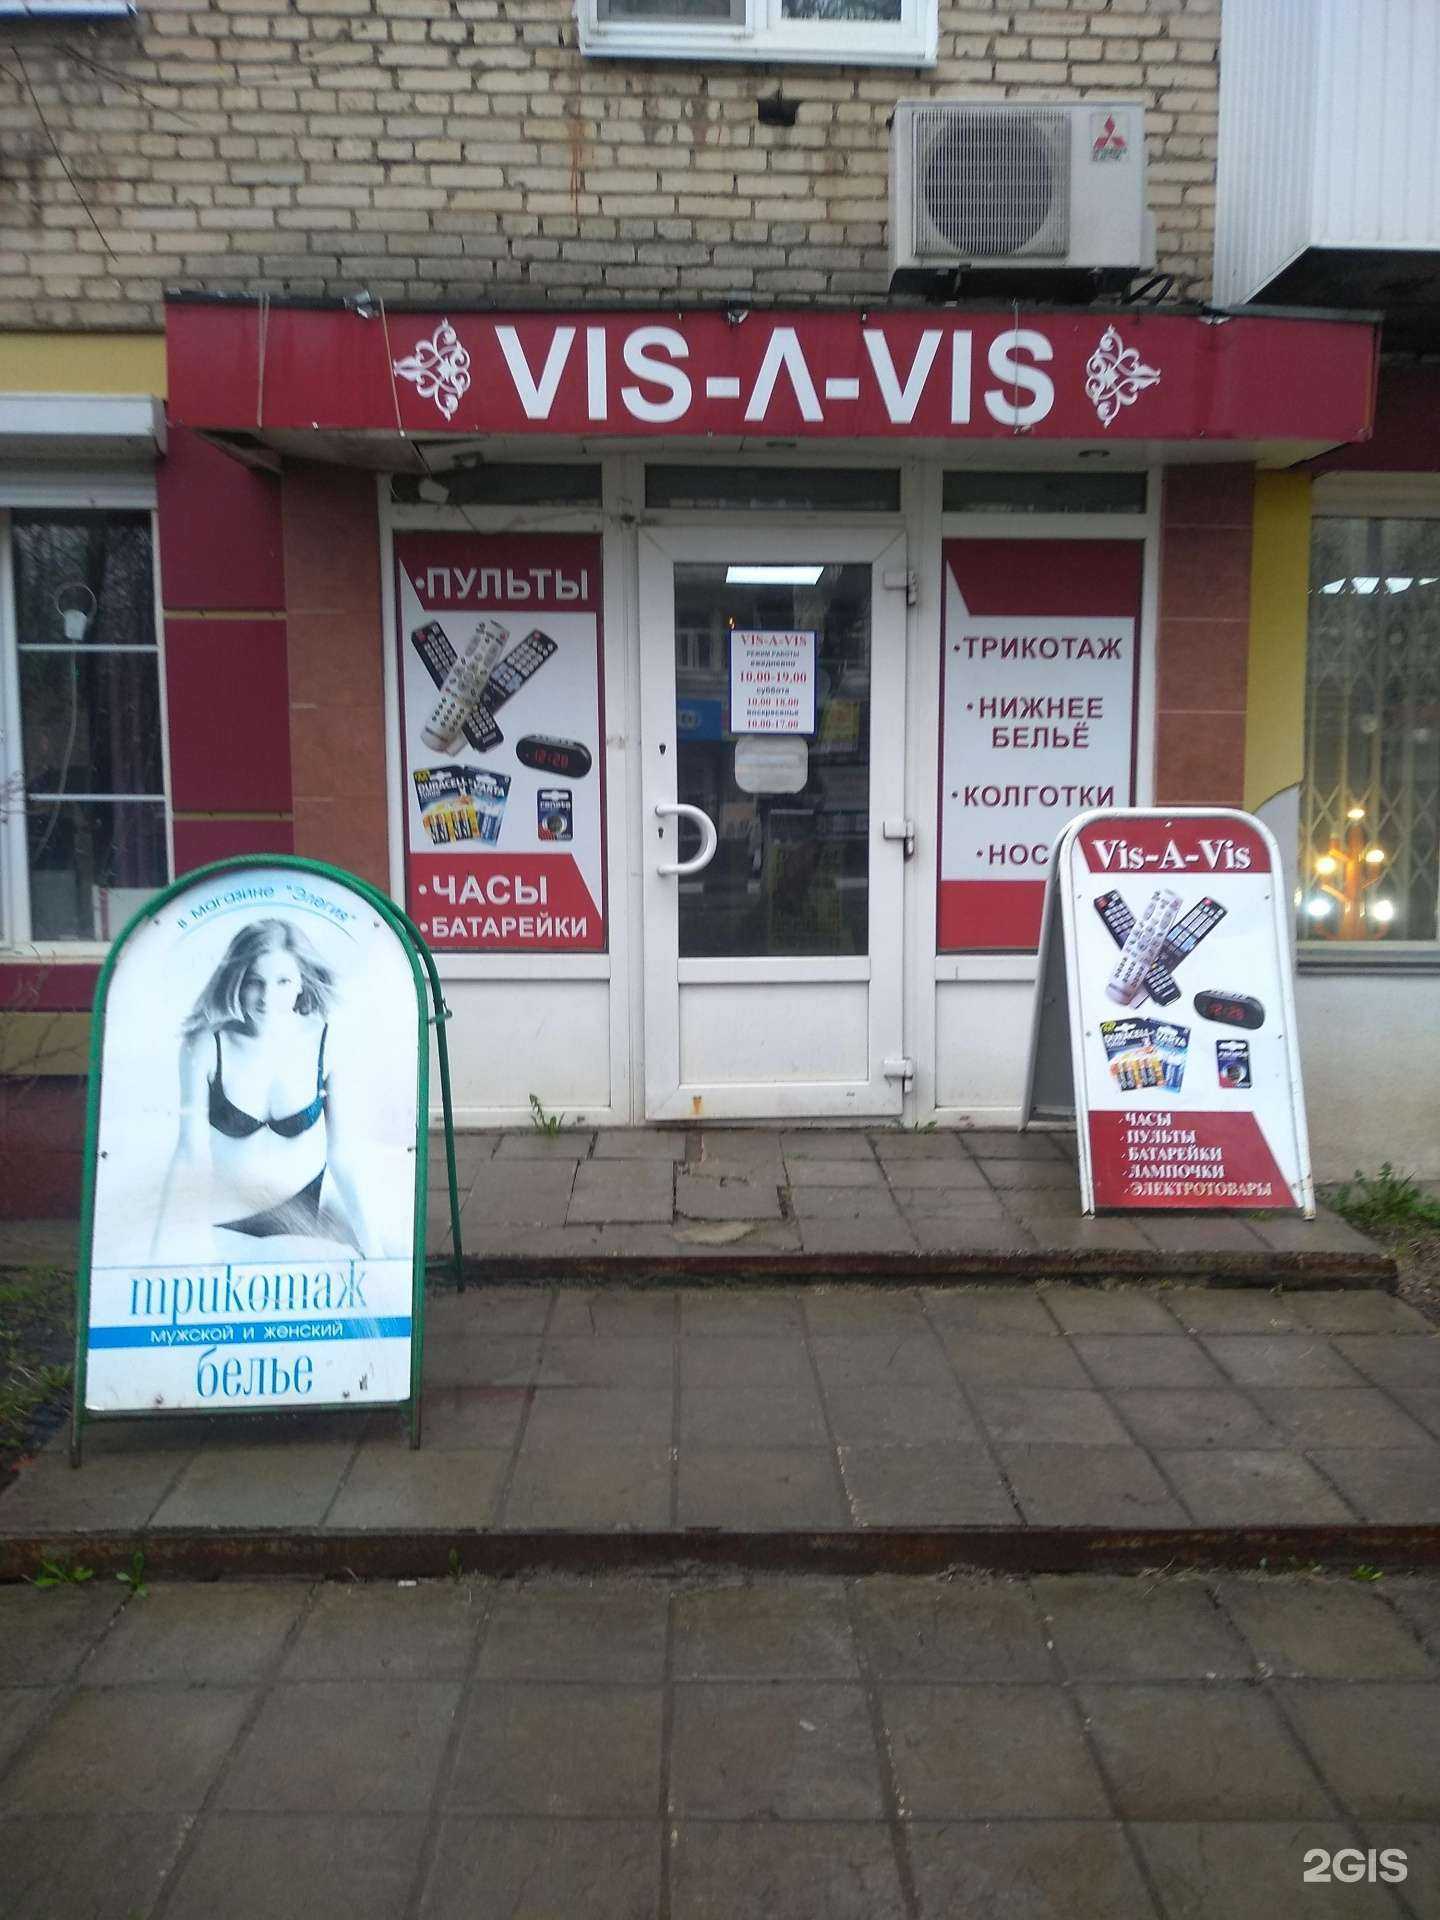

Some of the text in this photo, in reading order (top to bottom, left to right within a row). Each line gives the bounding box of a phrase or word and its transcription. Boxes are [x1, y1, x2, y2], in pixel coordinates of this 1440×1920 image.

[494, 325, 1055, 426] VIS-A-VIS
[427, 568, 588, 600] ПУЛЬТЫ
[741, 634, 807, 647] VIS-A-VIS
[963, 636, 1122, 660] ТРИКОТАЖ
[979, 696, 1104, 719] НИЖНЕЕ
[992, 722, 1090, 749] БЕЛЬЁ
[964, 785, 1115, 808] КОЛГОТКИ
[988, 843, 1050, 866] НОС
[1091, 839, 1252, 870] Vis-A-Vis
[432, 874, 548, 905] ЧАСЫ
[191, 887, 275, 920] магазине
[432, 912, 587, 938] БАТАРЕЙКИ
[1125, 1112, 1172, 1127] ЧАСЫ
[1127, 1129, 1196, 1144] ПУЛЬТЫ
[1128, 1145, 1223, 1161] БАТАРЕЙКИ
[1128, 1164, 1225, 1179] ЛАМПОЧКИ
[1130, 1182, 1273, 1197] ЭЛЕКТРОТОВАРЫ
[129, 1258, 368, 1326] трикотаж
[150, 1320, 344, 1346] мужской и женский
[196, 1345, 313, 1398] белье
